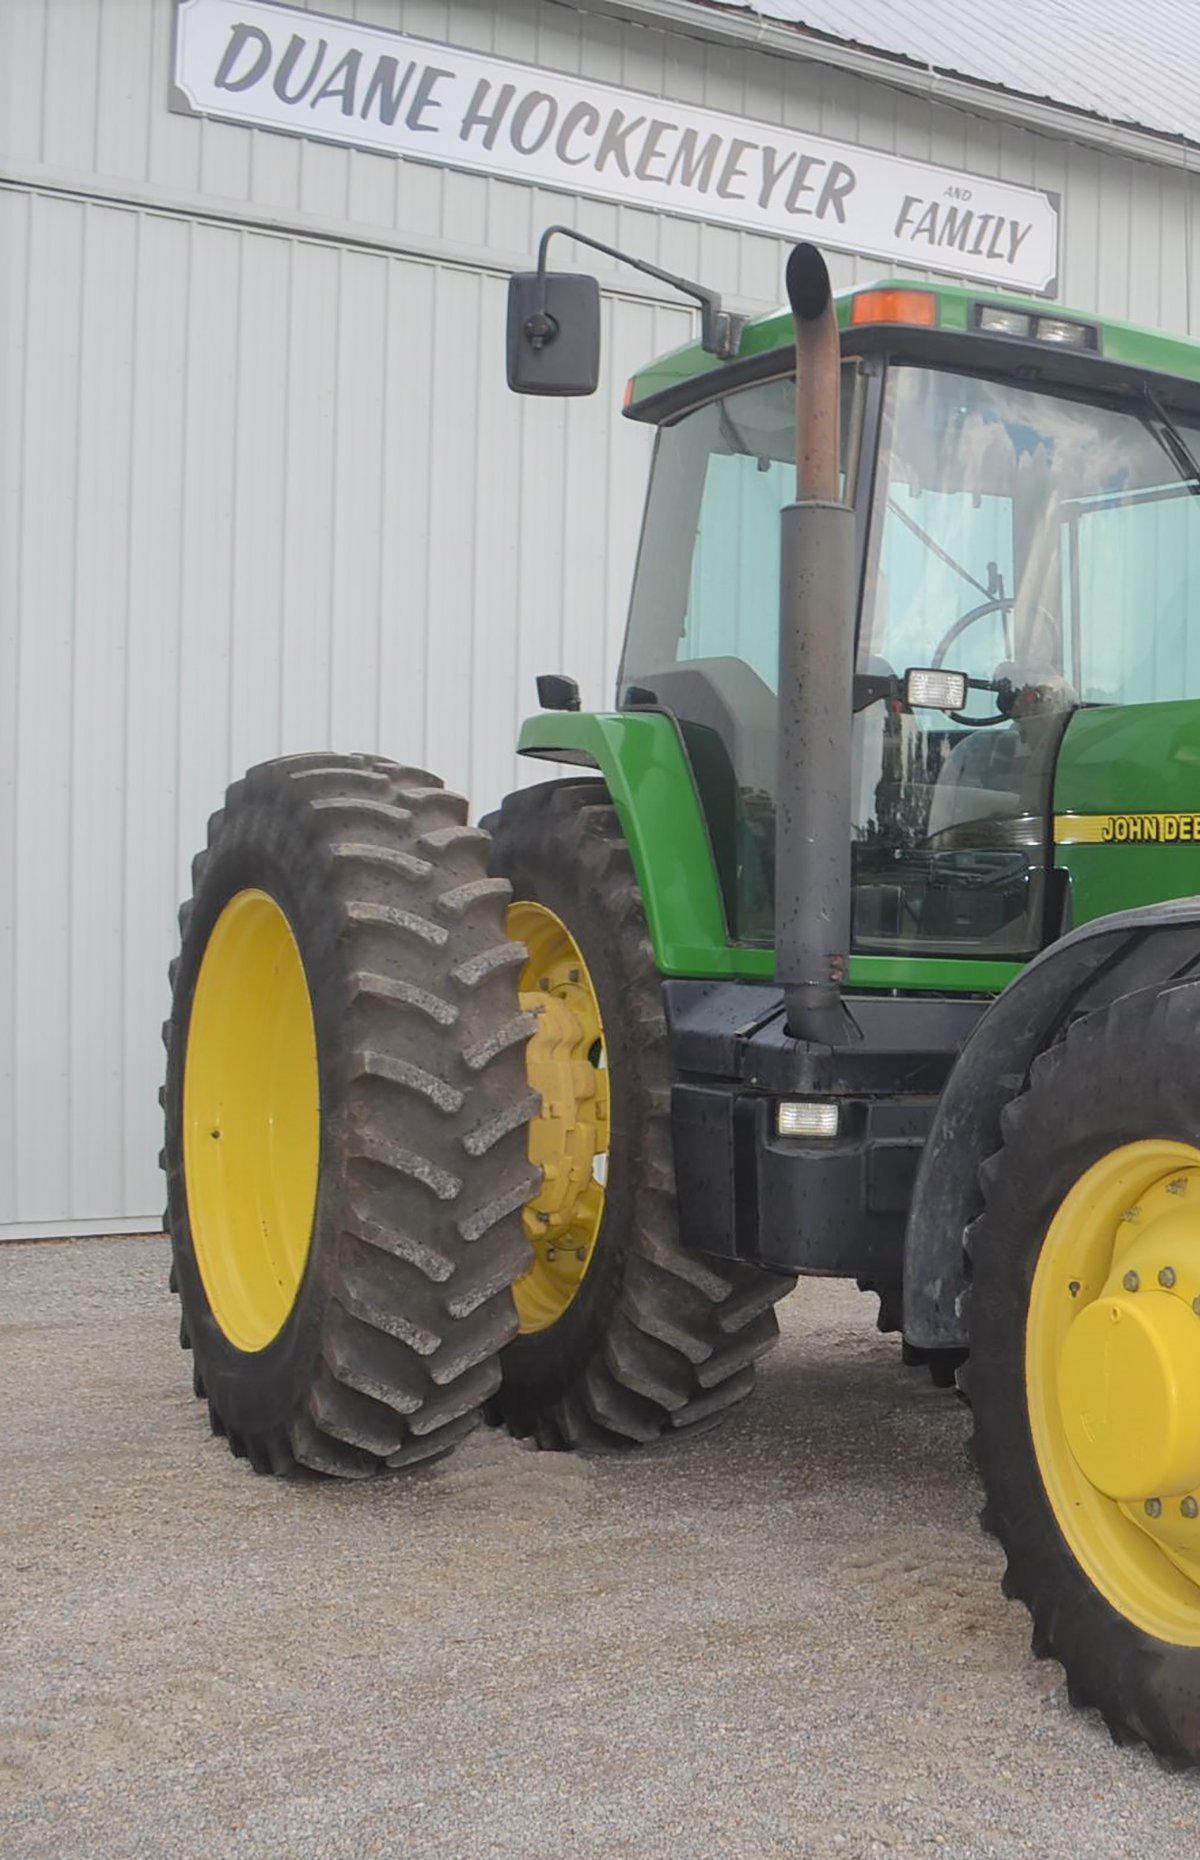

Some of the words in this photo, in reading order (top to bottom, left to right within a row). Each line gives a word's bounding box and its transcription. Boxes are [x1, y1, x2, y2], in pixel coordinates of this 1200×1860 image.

[214, 22, 457, 133] DUANE
[459, 78, 856, 224] HOCKEMEYER
[943, 186, 973, 201] AND
[894, 195, 1033, 264] FAMILY
[1102, 816, 1160, 842] JOHN
